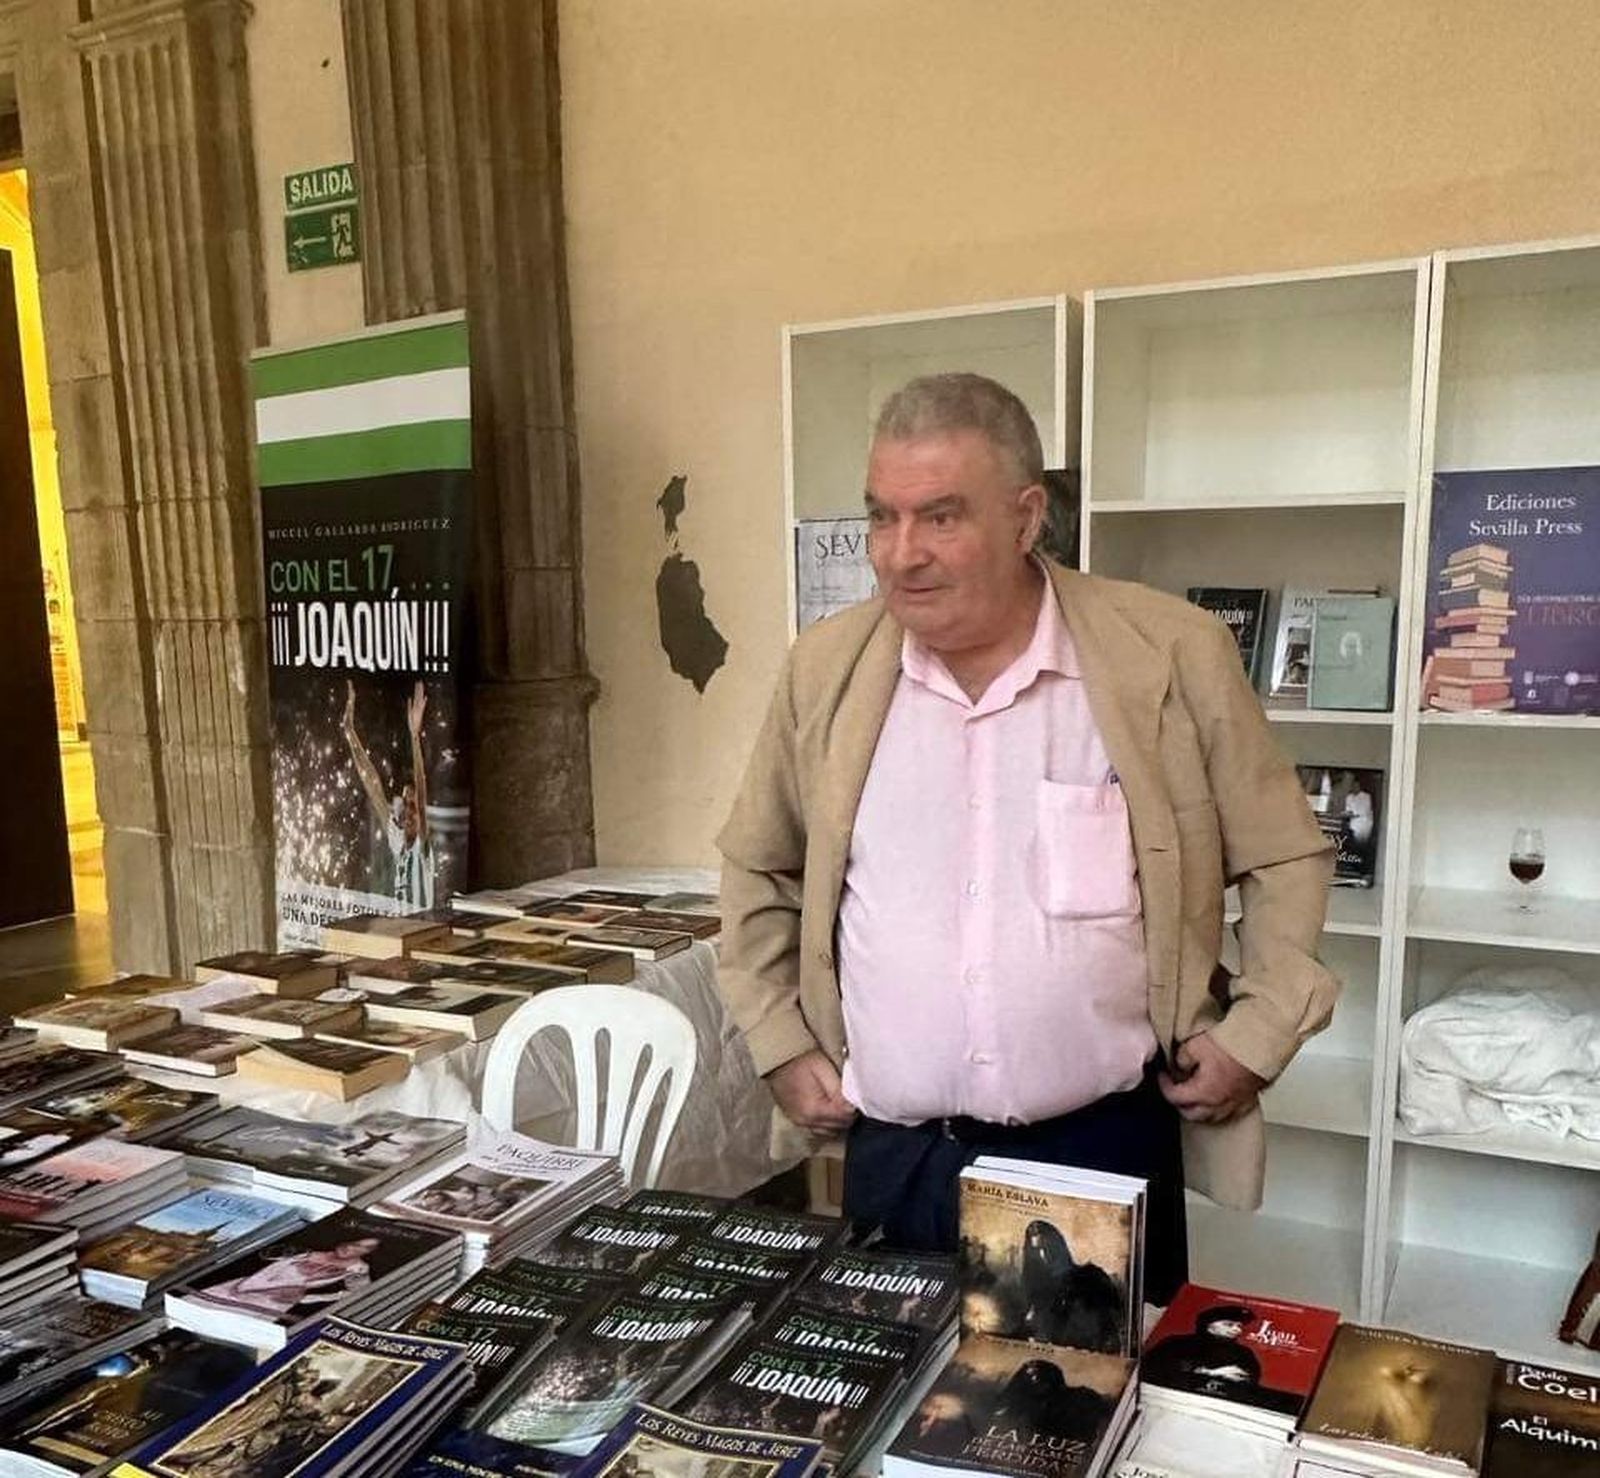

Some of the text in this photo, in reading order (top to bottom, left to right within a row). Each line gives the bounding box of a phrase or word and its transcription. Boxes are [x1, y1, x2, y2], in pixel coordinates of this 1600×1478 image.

[290, 169, 353, 203] SALIDA
[1486, 493, 1577, 511] Ediciones
[1469, 517, 1583, 537] Sevilla Press
[815, 533, 869, 559] SEVI
[270, 561, 320, 593] CON
[328, 559, 358, 591] EL
[789, 1315, 826, 1331] CON
[852, 1328, 881, 1345] 17
[749, 1351, 787, 1368] CON
[808, 1360, 845, 1378] 17
[1518, 1374, 1597, 1403] Coel
[986, 1425, 1087, 1456] LA LUZ
[1500, 1418, 1597, 1450] Alquim
